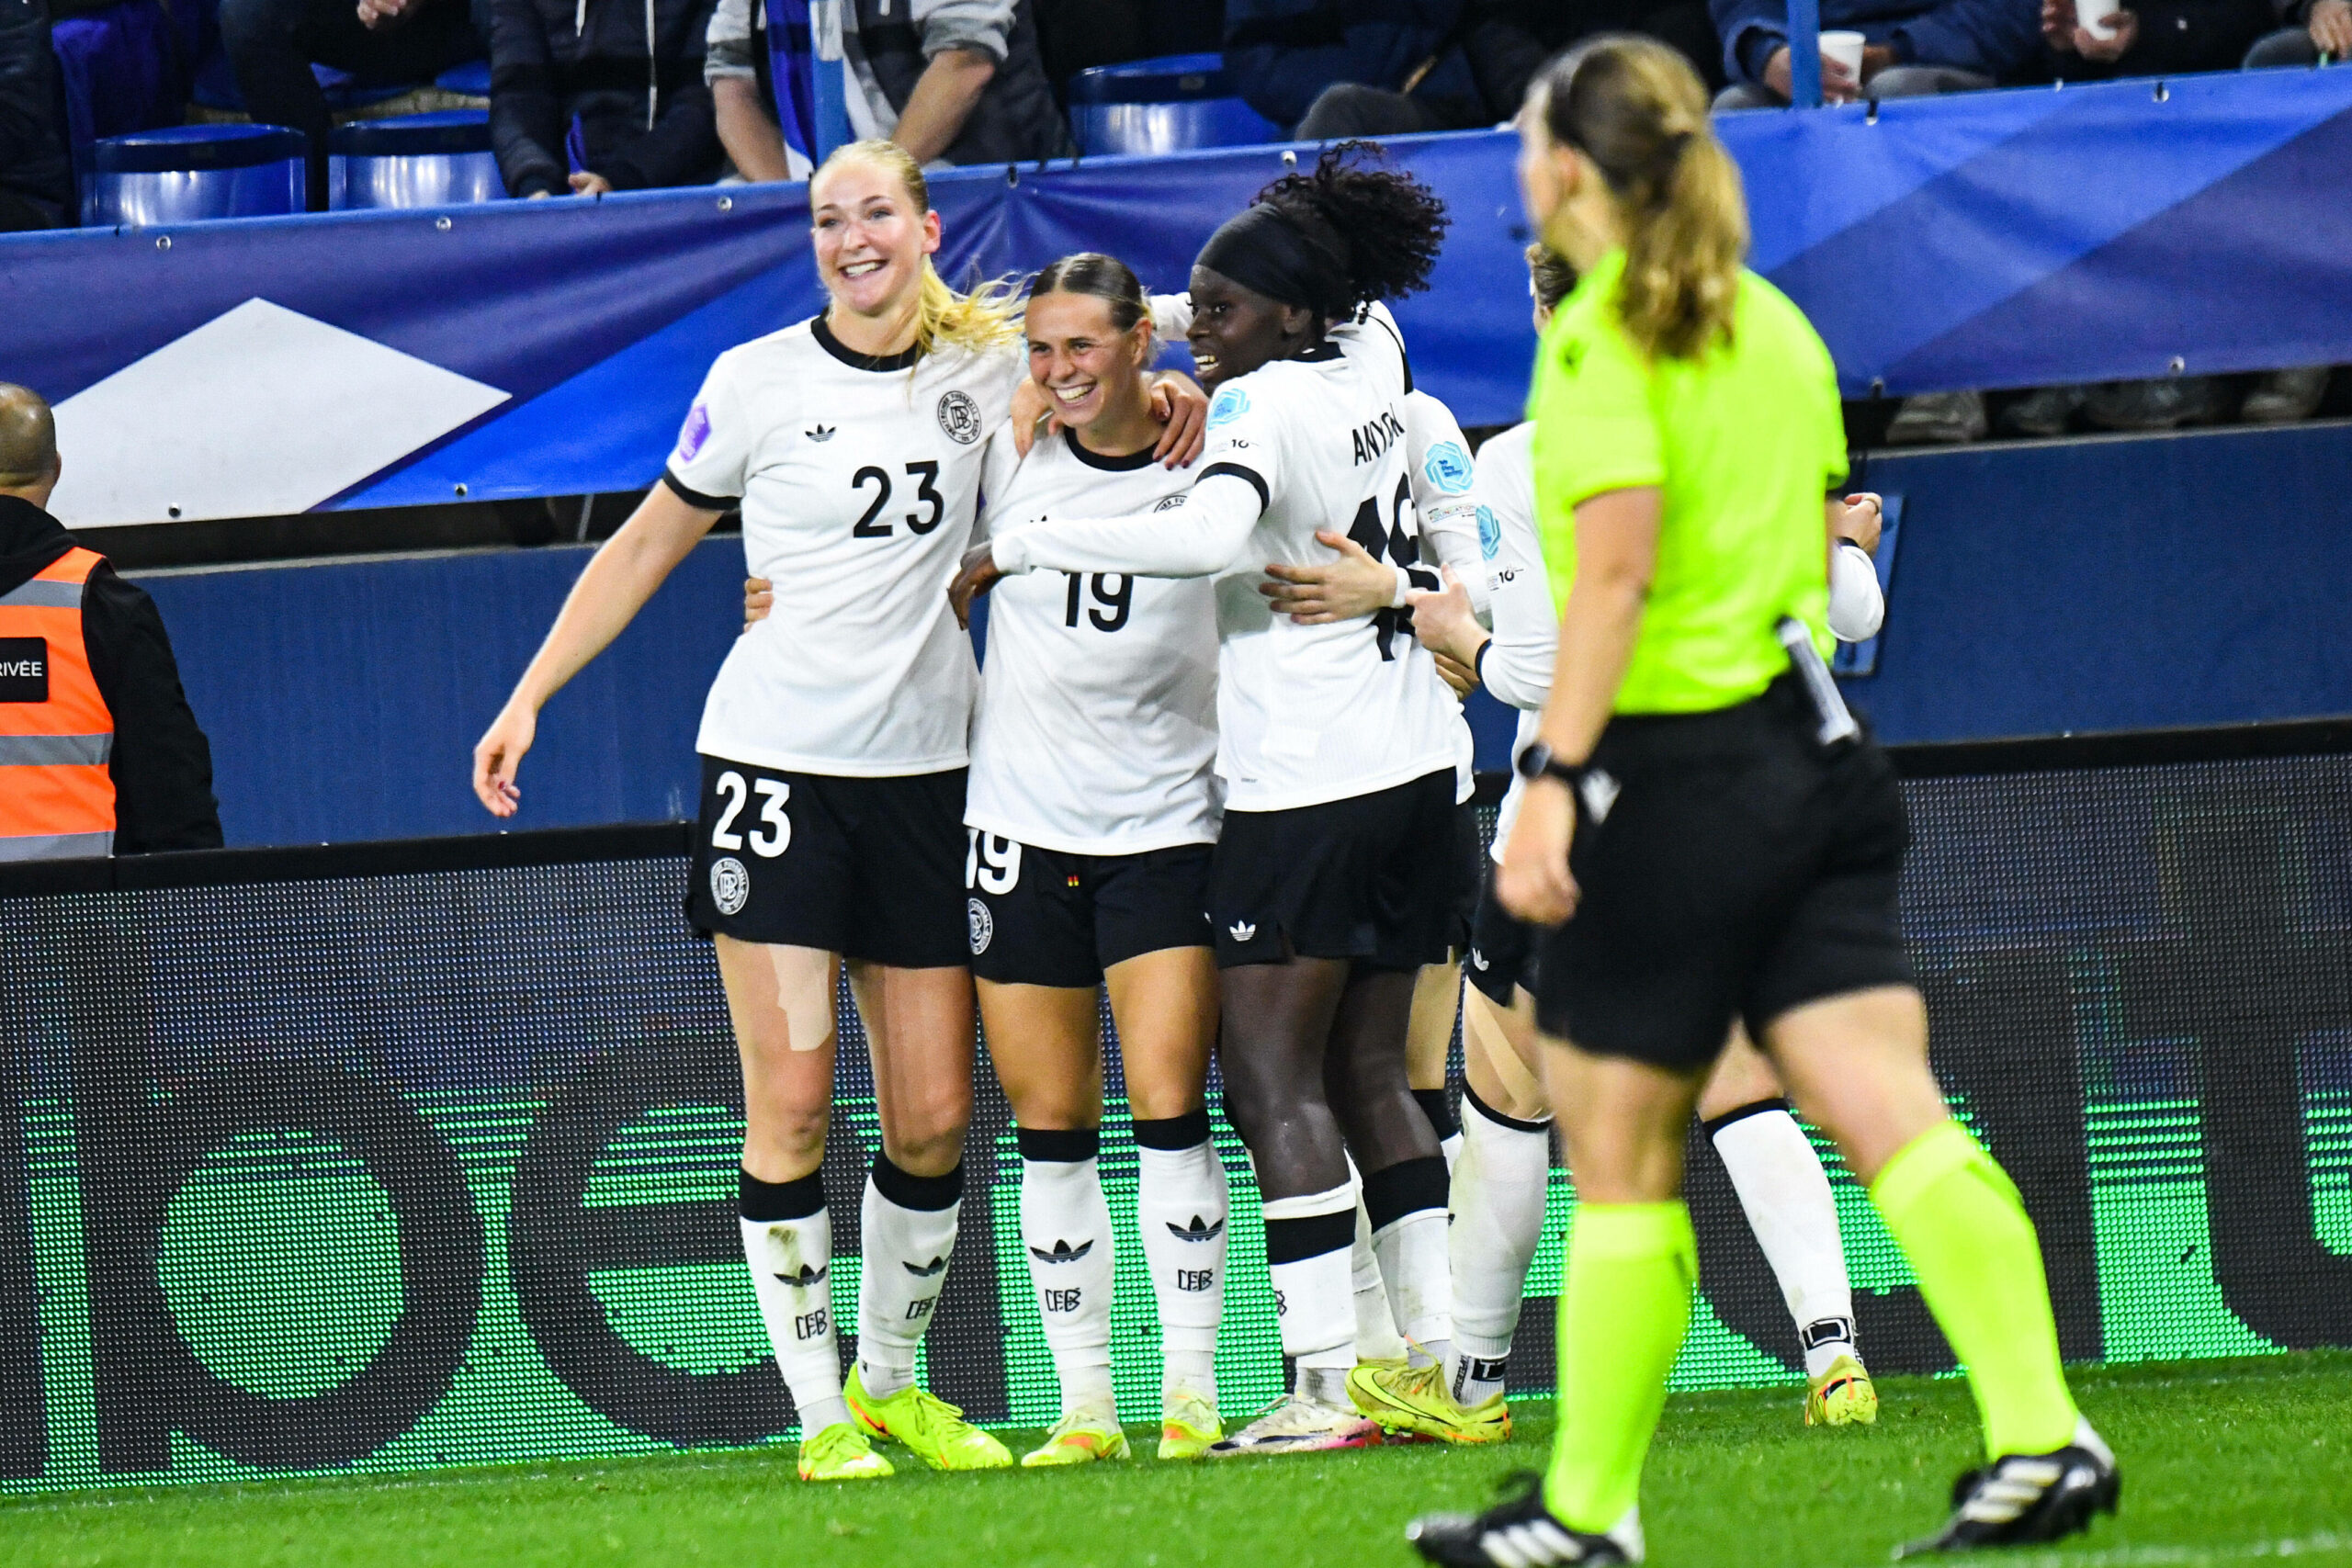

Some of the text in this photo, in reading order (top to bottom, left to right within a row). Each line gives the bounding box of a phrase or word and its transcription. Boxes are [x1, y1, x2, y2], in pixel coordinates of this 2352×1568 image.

[851, 459, 945, 538] 23
[1058, 571, 1135, 633] 19
[711, 770, 792, 859] 23
[965, 829, 1023, 896] 19
